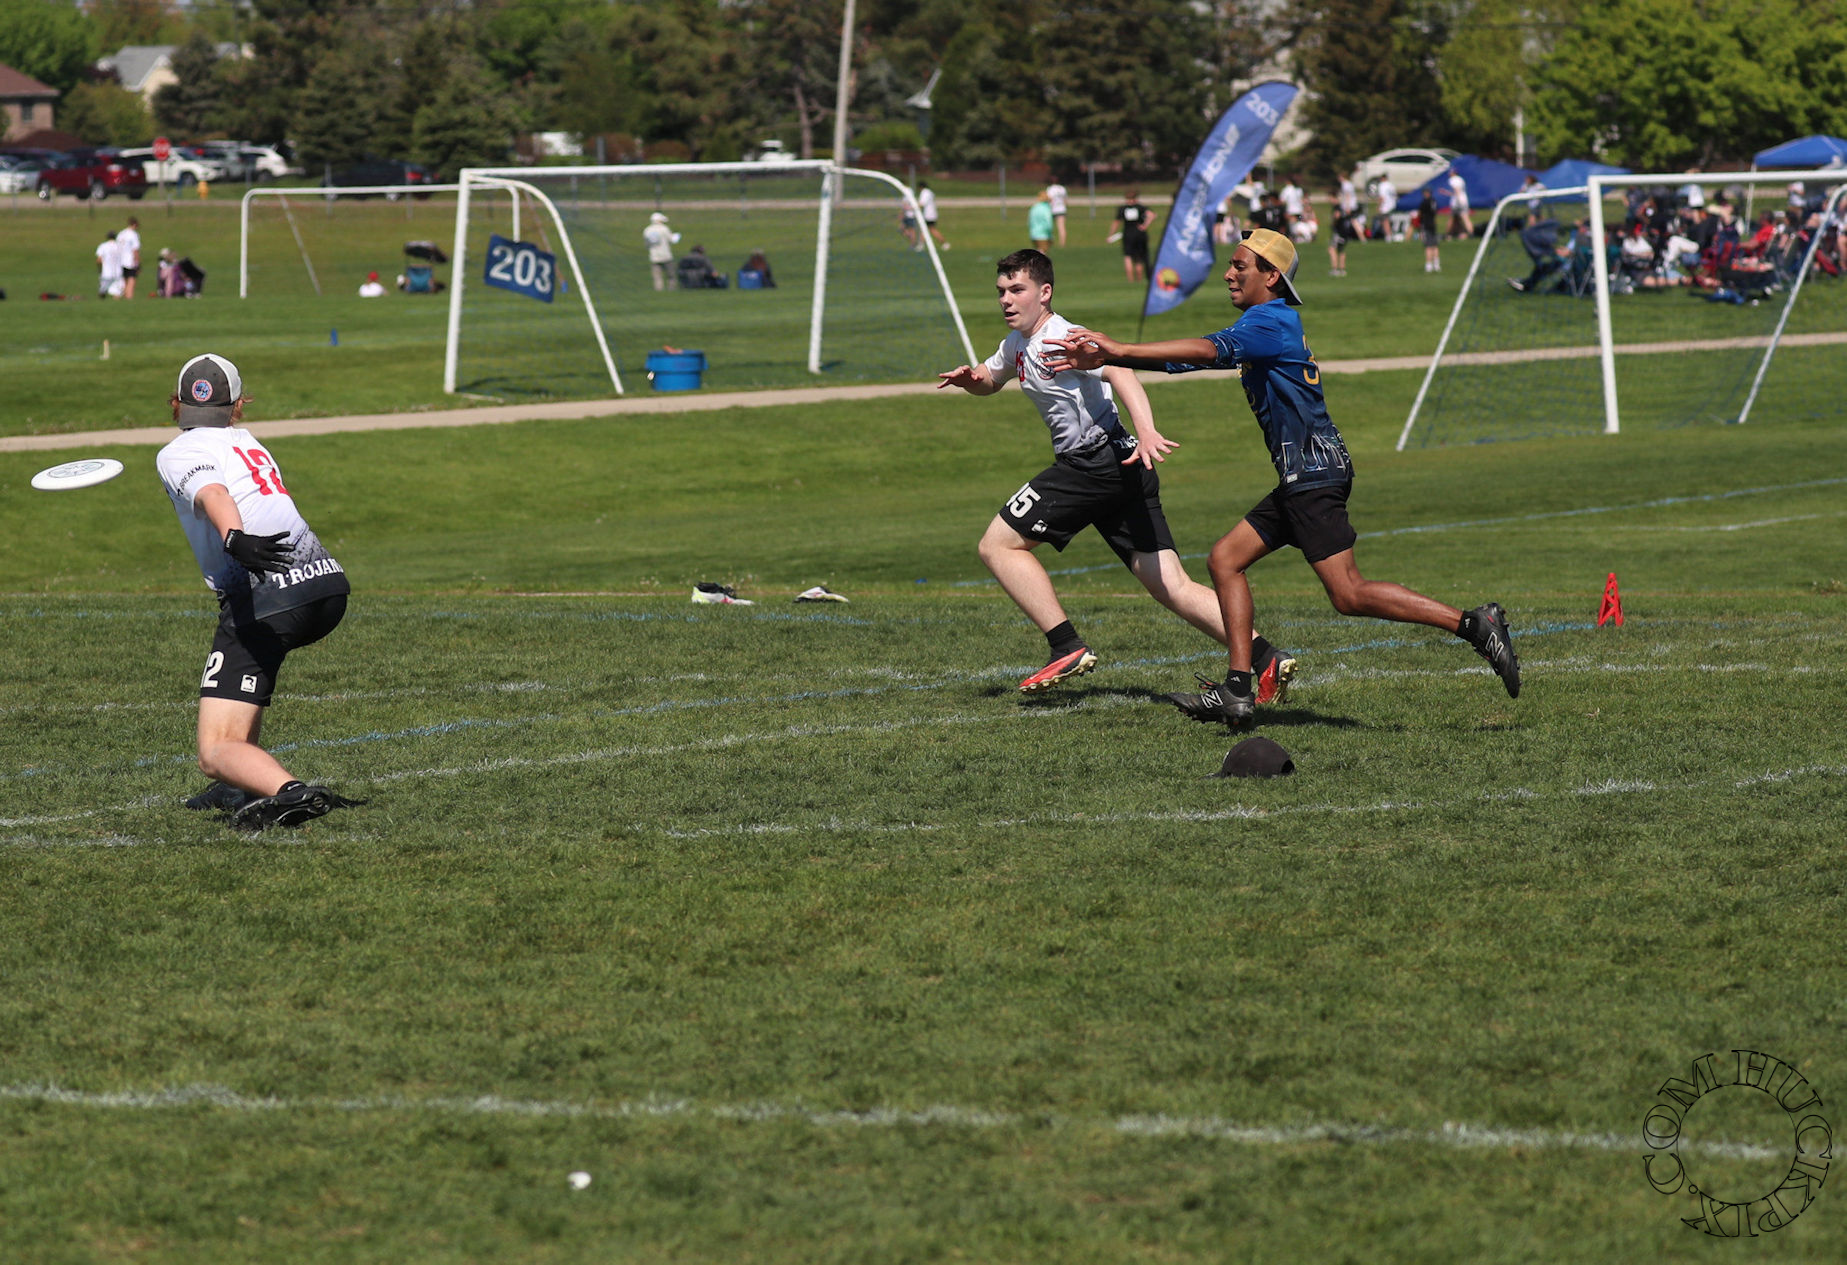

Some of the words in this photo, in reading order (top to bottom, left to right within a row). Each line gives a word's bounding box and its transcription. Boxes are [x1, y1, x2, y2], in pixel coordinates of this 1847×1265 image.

[1245, 92, 1280, 127] 203
[489, 245, 552, 294] 203
[180, 464, 217, 491] BREAKMARK
[232, 446, 290, 497] 12
[200, 651, 225, 688] 2
